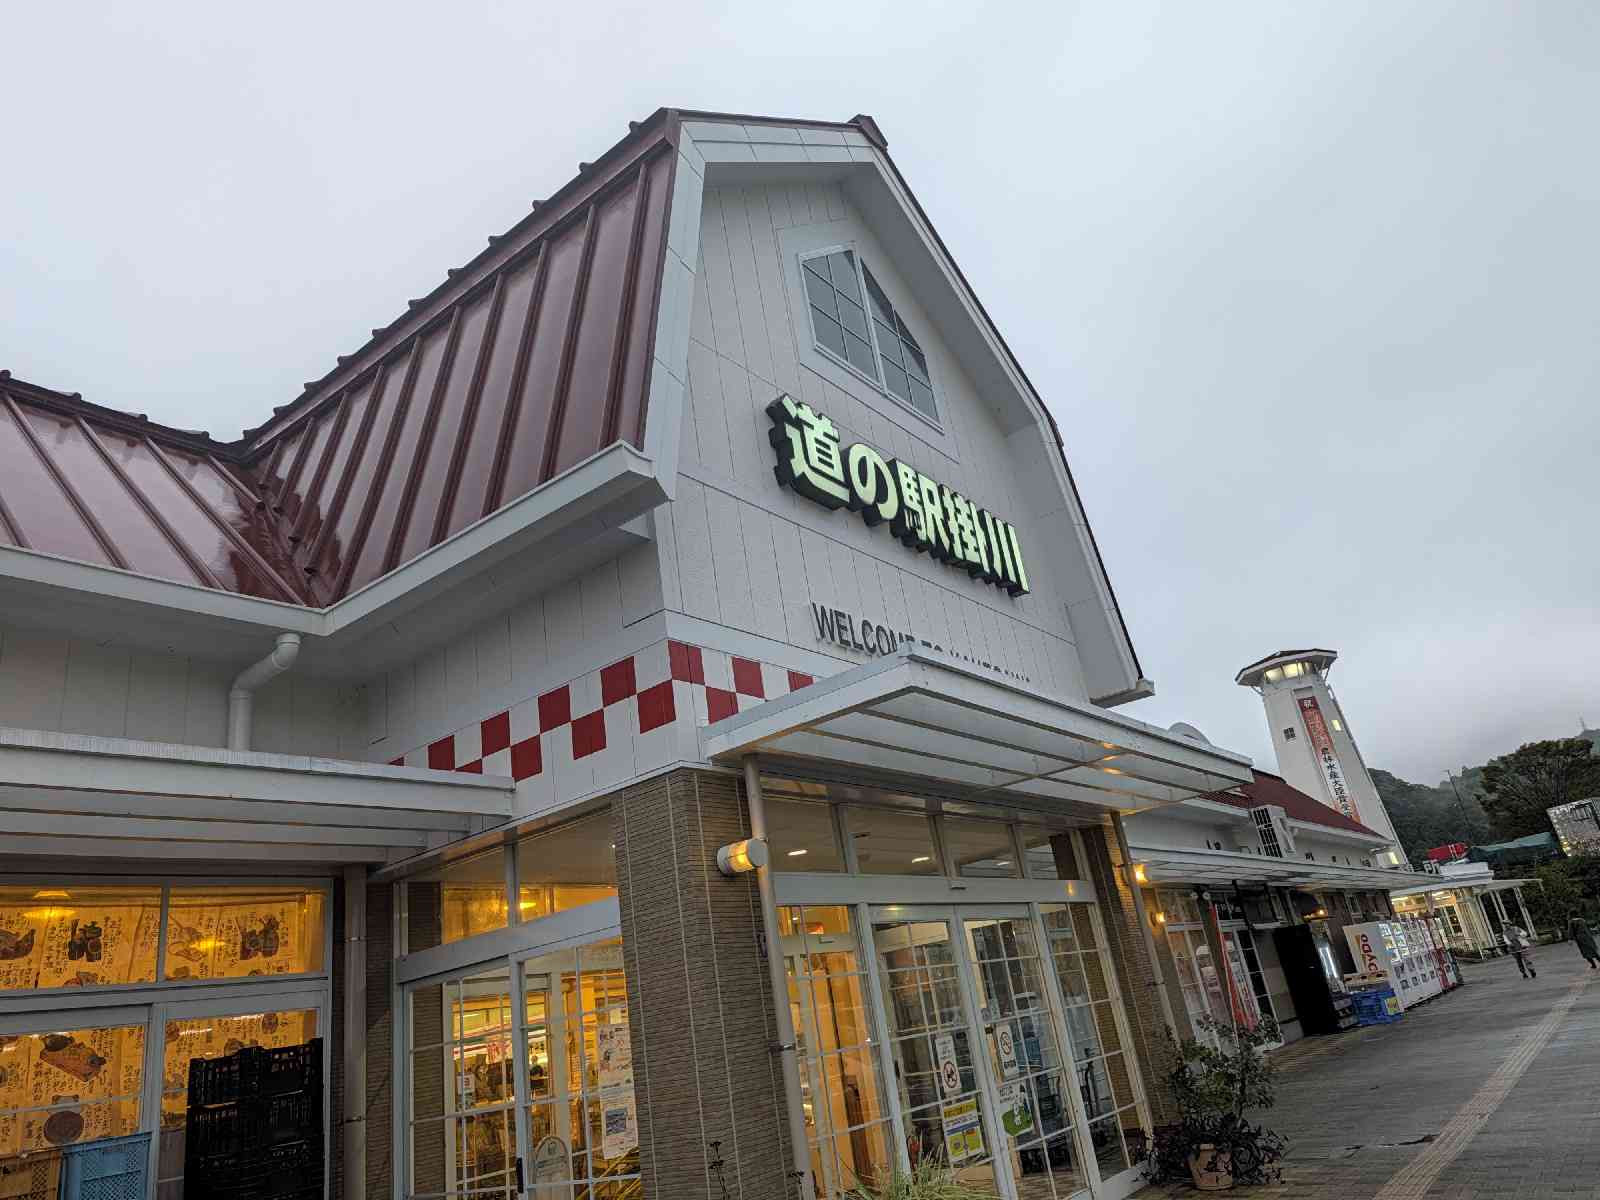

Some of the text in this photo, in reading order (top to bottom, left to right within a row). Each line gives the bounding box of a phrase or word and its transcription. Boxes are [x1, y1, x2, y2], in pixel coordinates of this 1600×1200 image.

[778, 395, 1030, 594] 道の駅掛川
[811, 601, 915, 656] WELCOM
